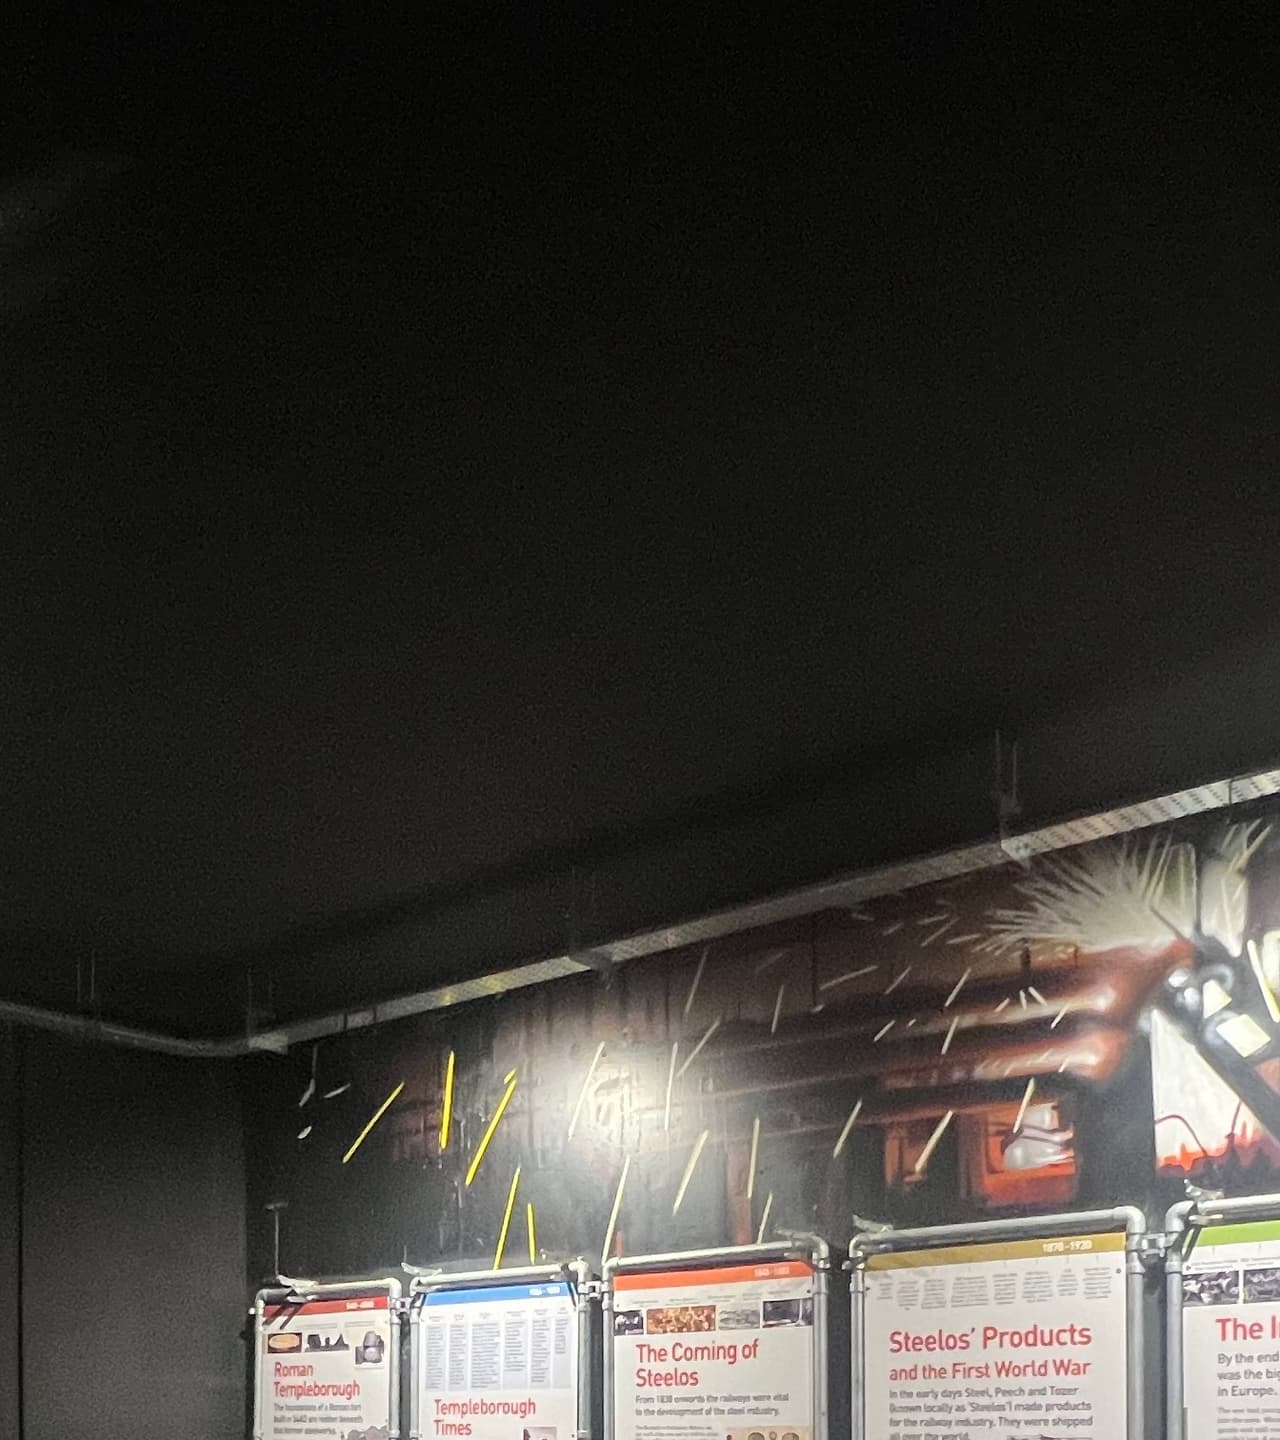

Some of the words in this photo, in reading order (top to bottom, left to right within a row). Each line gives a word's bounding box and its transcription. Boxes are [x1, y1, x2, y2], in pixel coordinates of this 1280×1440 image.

[982, 1323, 1092, 1349] Products
[1216, 1317, 1264, 1341] The
[635, 1344, 667, 1363] The
[671, 1340, 738, 1364] Coming
[742, 1338, 760, 1359] of
[1218, 1354, 1232, 1367] By
[1235, 1353, 1254, 1364] the
[1257, 1351, 1279, 1363] end
[274, 1361, 314, 1377] Roman
[636, 1367, 699, 1387] Steelos
[889, 1364, 918, 1381] and
[922, 1364, 947, 1379] the
[952, 1362, 990, 1379] First
[995, 1360, 1048, 1377] World
[1052, 1359, 1092, 1376] War
[1243, 1369, 1263, 1380] the
[274, 1380, 360, 1400] Templeborough
[941, 1388, 962, 1400] days
[1218, 1386, 1229, 1396] in
[1232, 1386, 1278, 1398] Europe.
[434, 1398, 536, 1418] Templeborough
[1045, 1400, 1092, 1413] products
[433, 1420, 472, 1436] Times
